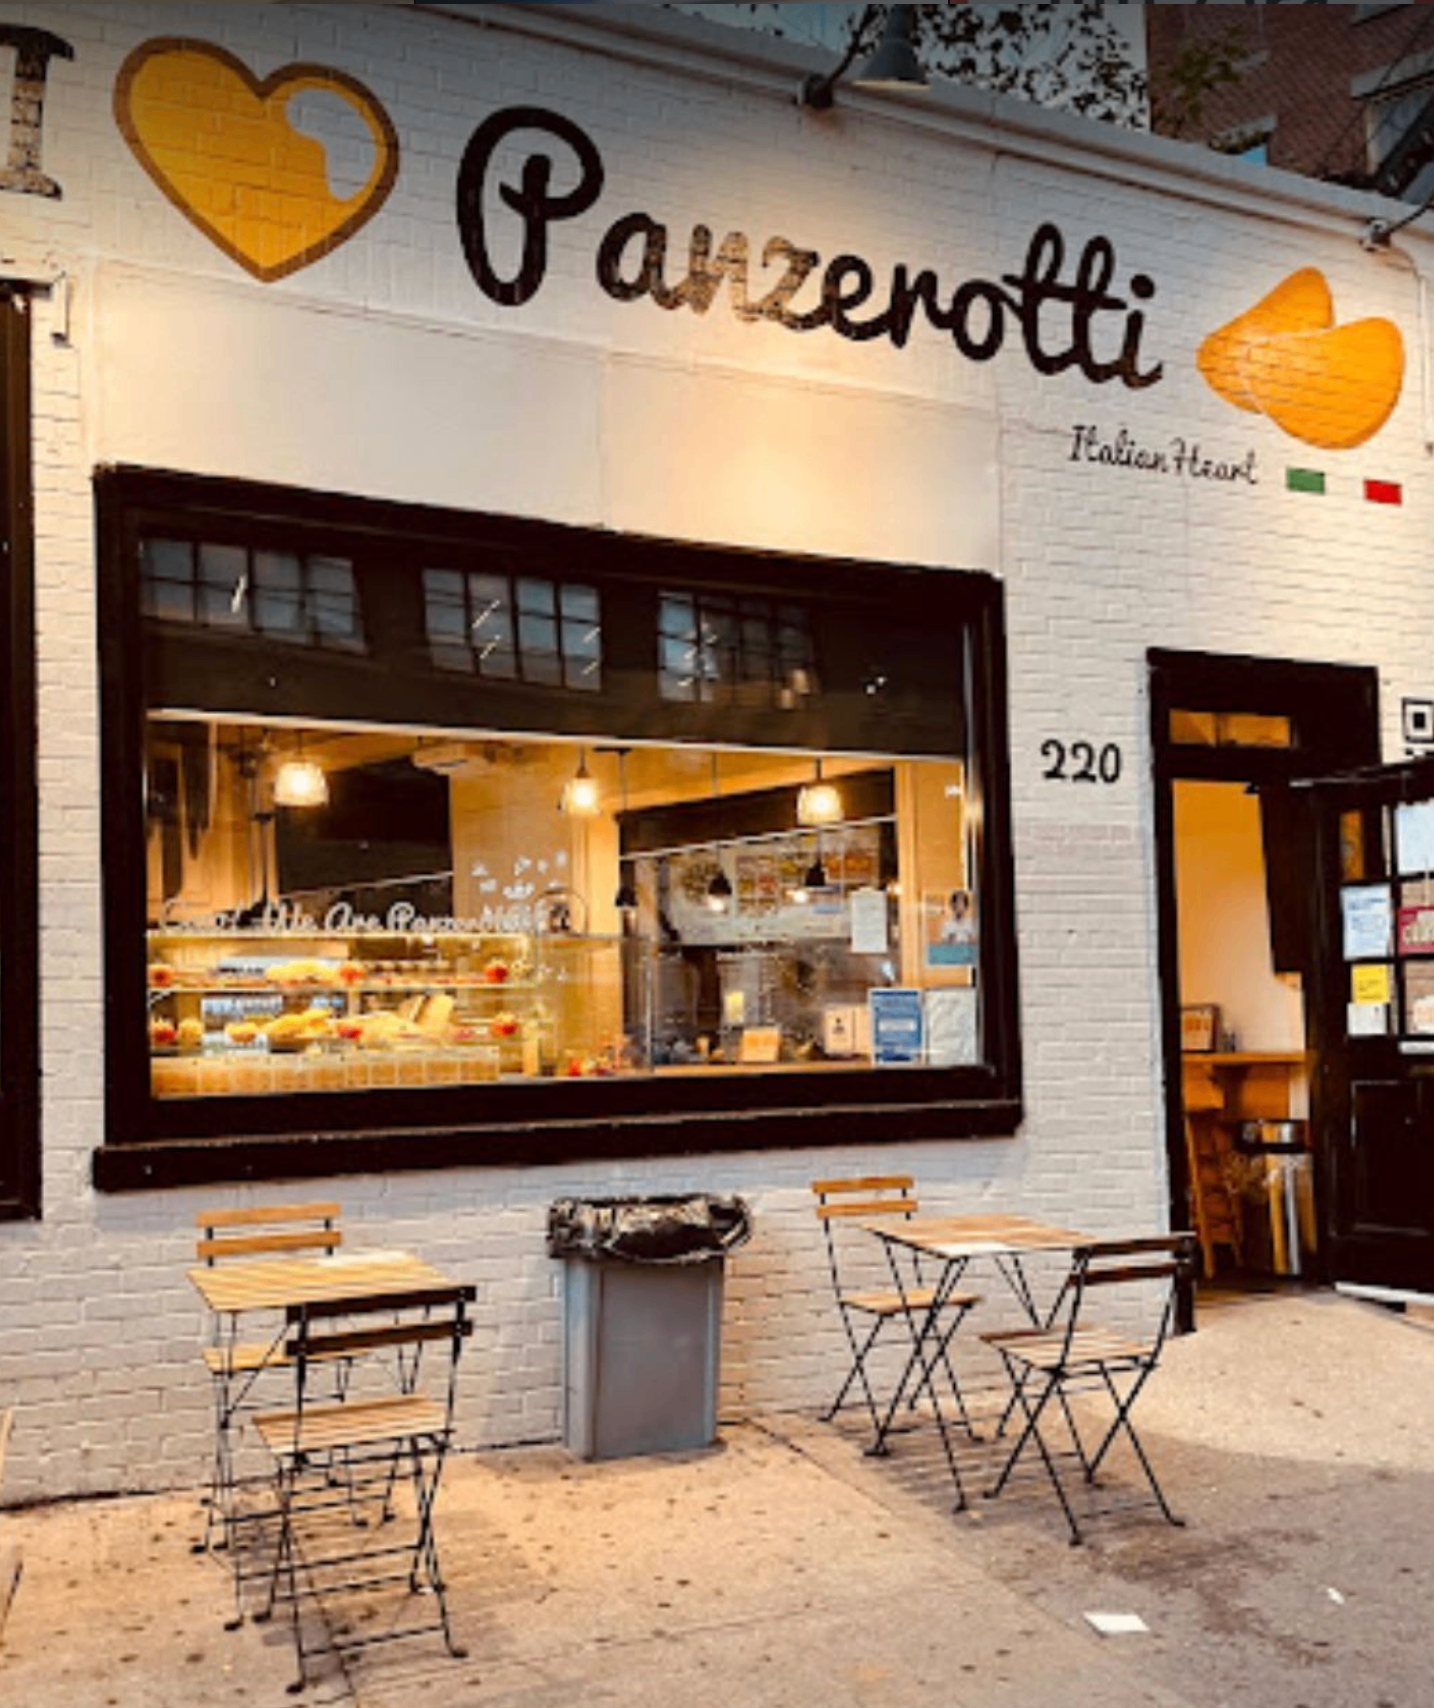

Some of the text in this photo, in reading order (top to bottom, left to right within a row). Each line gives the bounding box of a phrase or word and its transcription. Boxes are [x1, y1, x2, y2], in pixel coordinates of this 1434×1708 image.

[0, 22, 1164, 390] I Panzerotti
[1069, 424, 1258, 485] Italian Heart
[1040, 739, 1121, 784] 220
